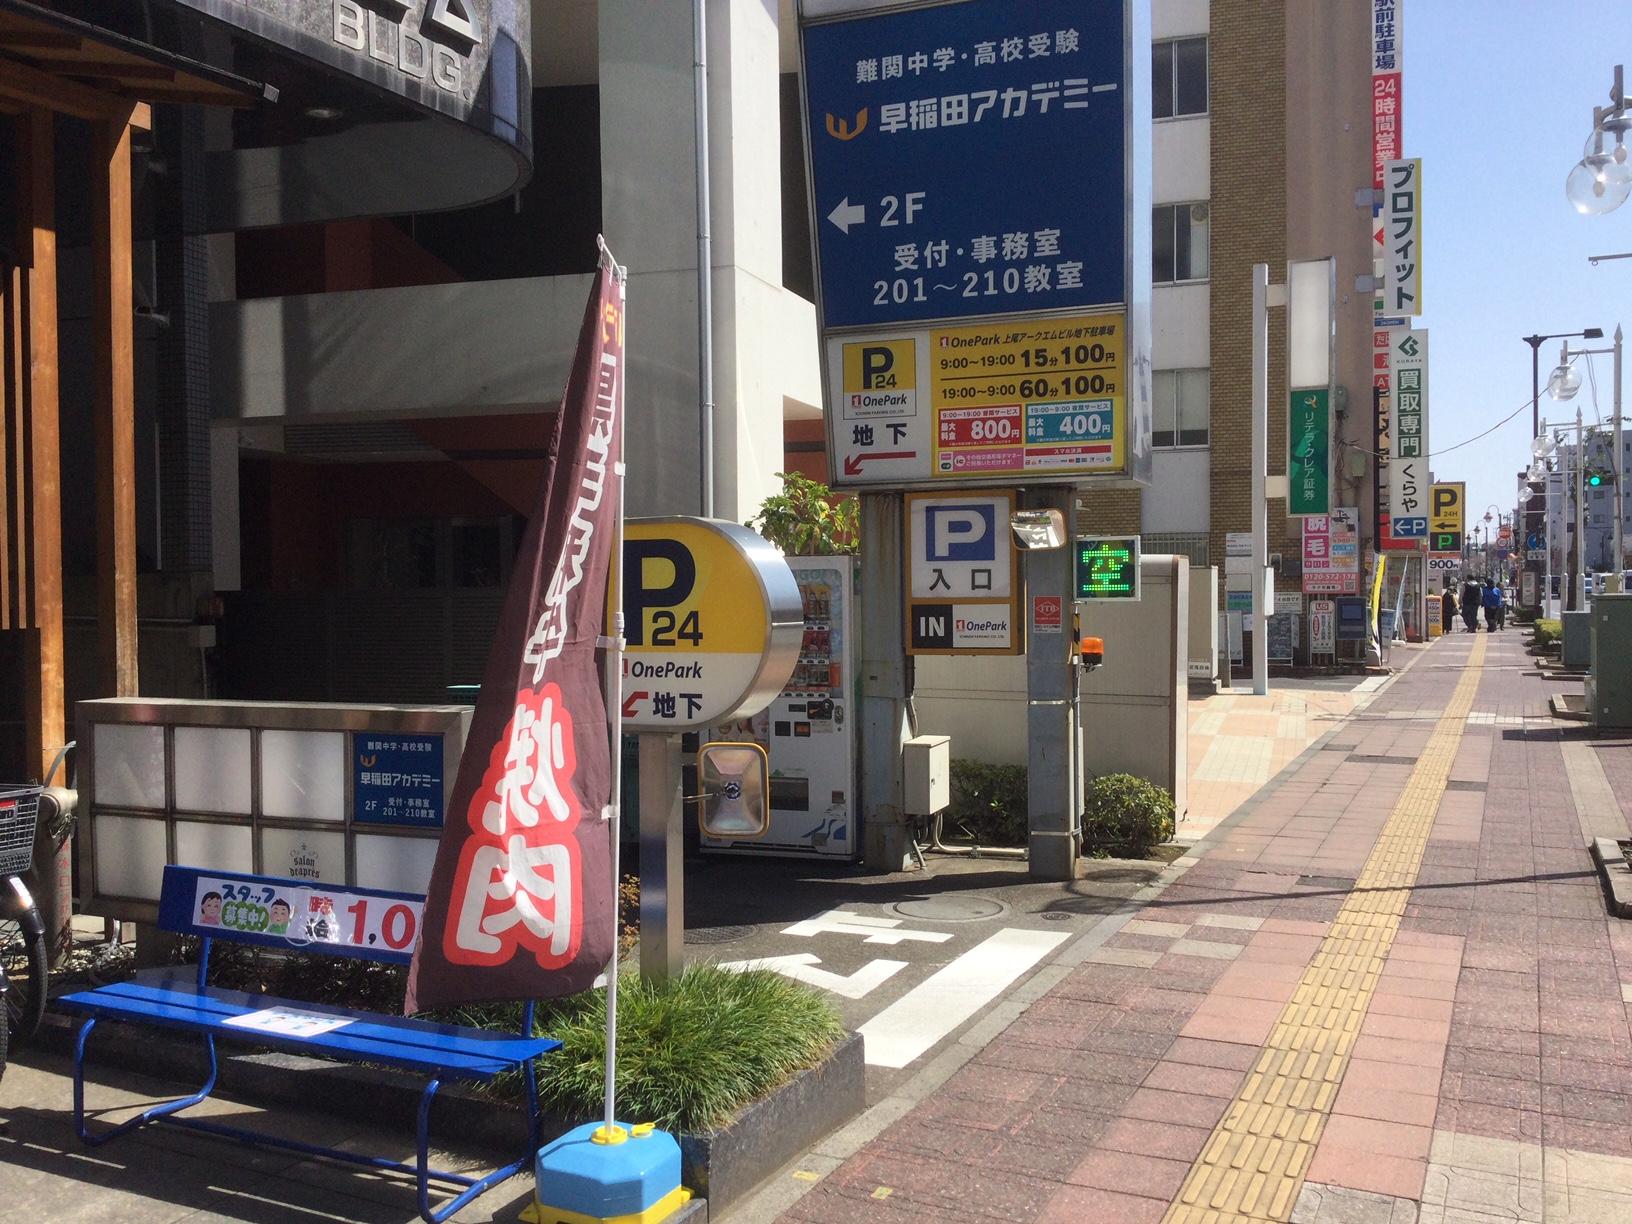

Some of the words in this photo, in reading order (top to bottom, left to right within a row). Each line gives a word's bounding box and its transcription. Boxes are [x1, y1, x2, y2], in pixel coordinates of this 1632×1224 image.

[856, 28, 1080, 83] 難関中学・高校受験
[879, 78, 1118, 133] 早稲田アカデミー
[880, 192, 926, 227] 2F
[1391, 163, 1415, 310] プロフィット
[894, 228, 1061, 272] 受付・事務室
[951, 335, 1000, 348] OnePark
[862, 347, 894, 390] P
[875, 374, 897, 388] 24
[863, 393, 907, 407] OnePark
[1399, 370, 1421, 457] 買取専門
[853, 423, 907, 446] 地下
[1402, 464, 1417, 513] くらや
[1434, 489, 1458, 517] P
[934, 510, 987, 557] P
[1413, 519, 1426, 534] P
[1439, 534, 1452, 549] P
[929, 568, 992, 591] 入口
[1082, 544, 1129, 591] 空
[617, 538, 696, 646] P
[652, 610, 703, 647] 24
[920, 617, 944, 637] IN
[966, 621, 1007, 631] OnePark
[631, 661, 703, 679] OnePark
[653, 692, 703, 720] 地下
[361, 772, 441, 787] 早稲田アカデミー
[365, 800, 377, 810] 2F
[293, 855, 315, 866] salon
[222, 884, 275, 903] スタッフ
